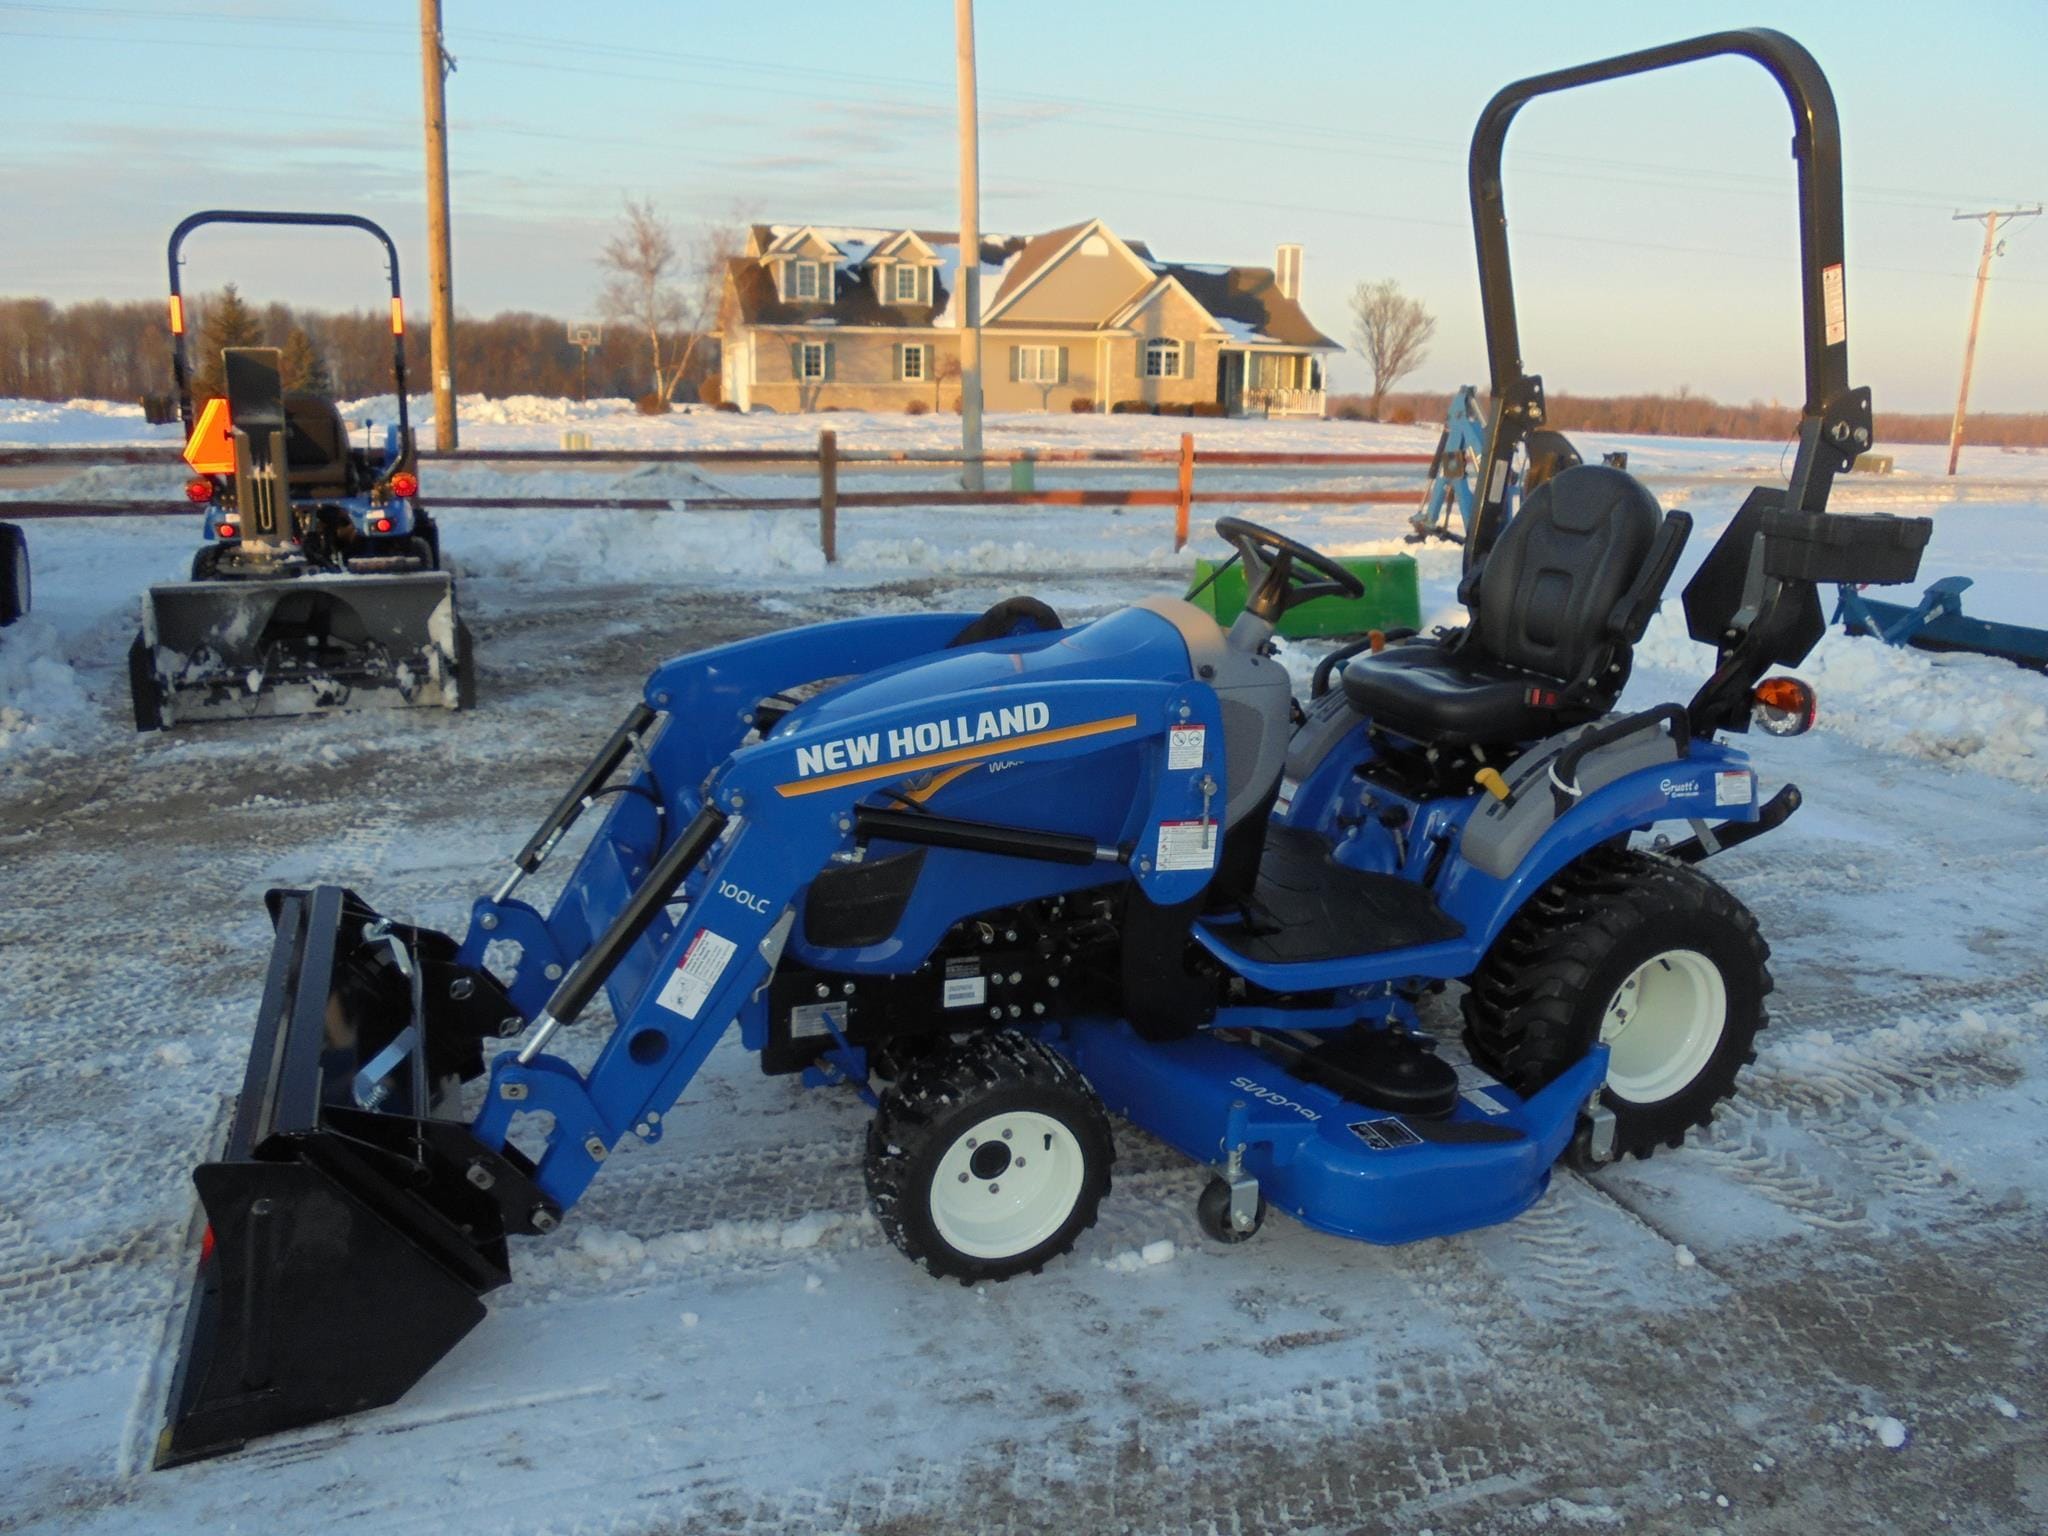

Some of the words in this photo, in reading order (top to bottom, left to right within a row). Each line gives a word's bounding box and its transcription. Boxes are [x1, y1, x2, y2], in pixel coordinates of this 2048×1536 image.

[796, 732, 881, 777] NEW
[887, 702, 1049, 759] HOLLAND
[717, 880, 771, 914] 100LC
